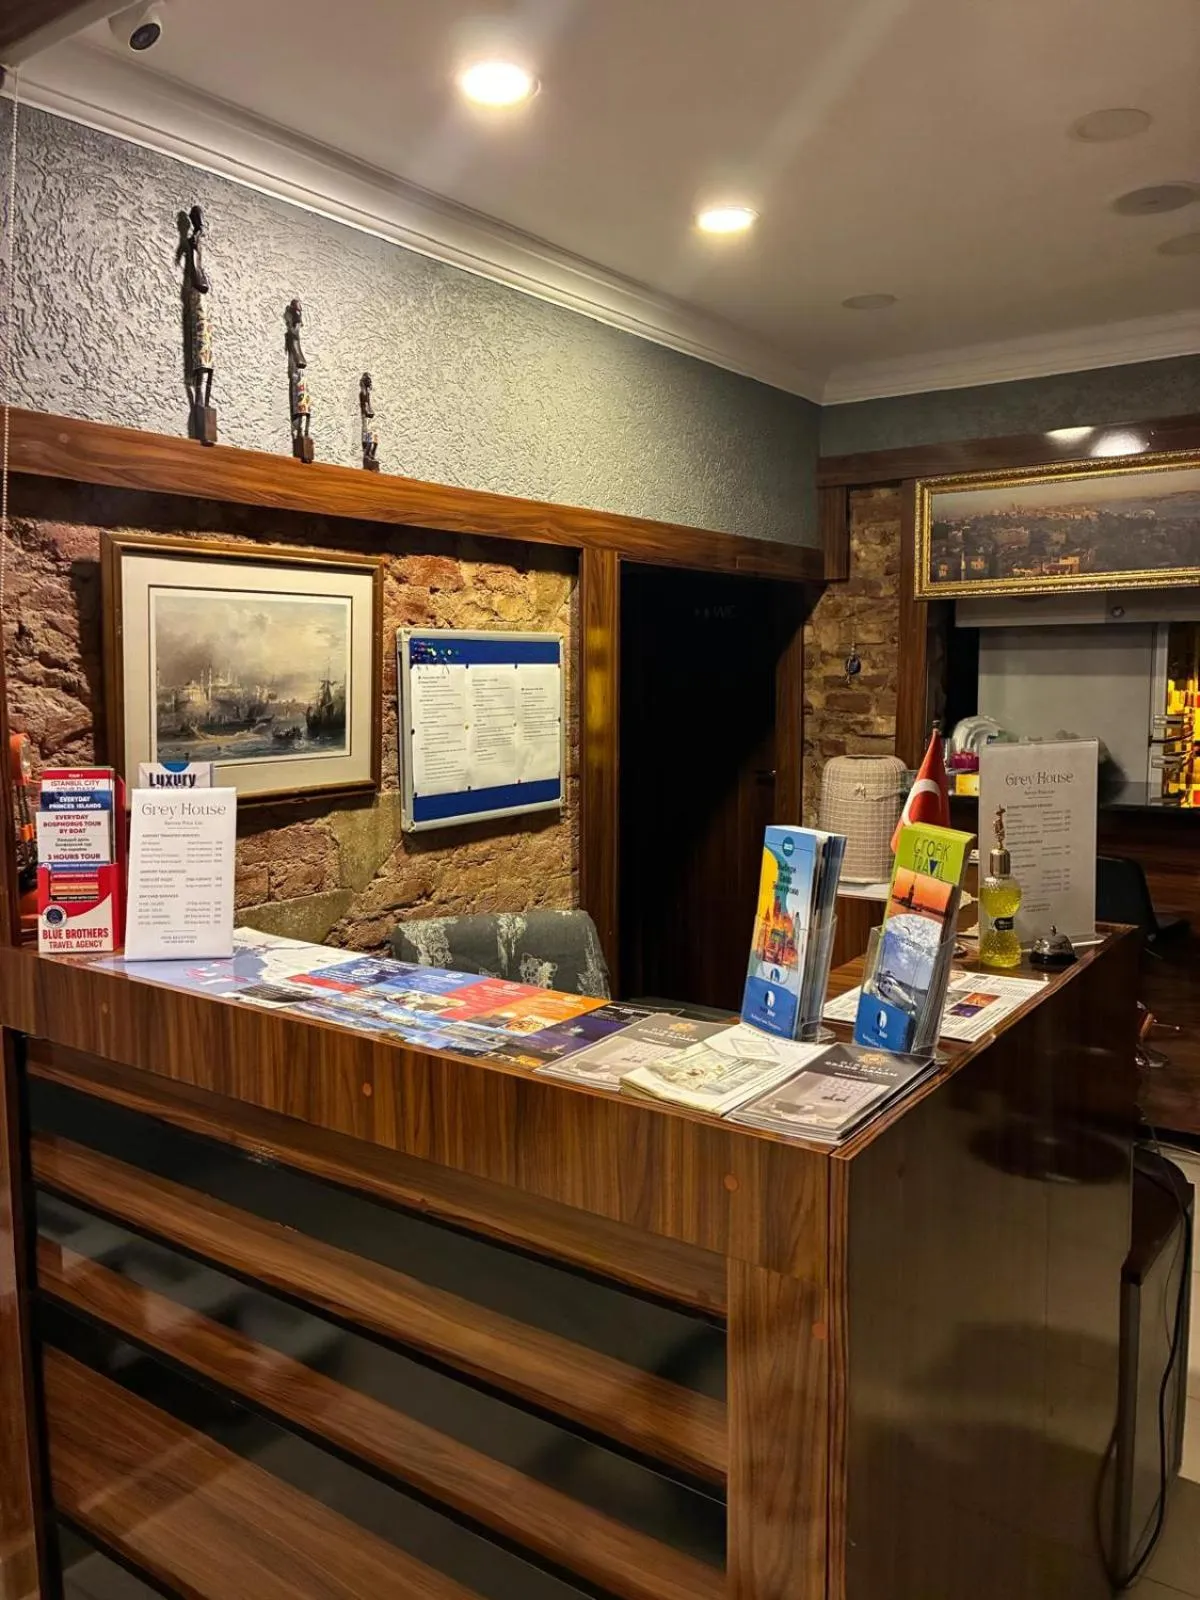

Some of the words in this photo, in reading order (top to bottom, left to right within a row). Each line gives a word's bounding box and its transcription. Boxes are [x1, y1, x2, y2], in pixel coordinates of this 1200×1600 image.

[149, 772, 196, 788] Luxury
[1005, 773, 1034, 789] Grey
[1037, 771, 1074, 785] House
[142, 803, 178, 819] Grey
[181, 803, 226, 816] House
[42, 929, 63, 939] BLUE
[65, 928, 109, 939] BROTHERS
[49, 941, 73, 949] TRAVEL
[76, 940, 103, 948] AGENCY
